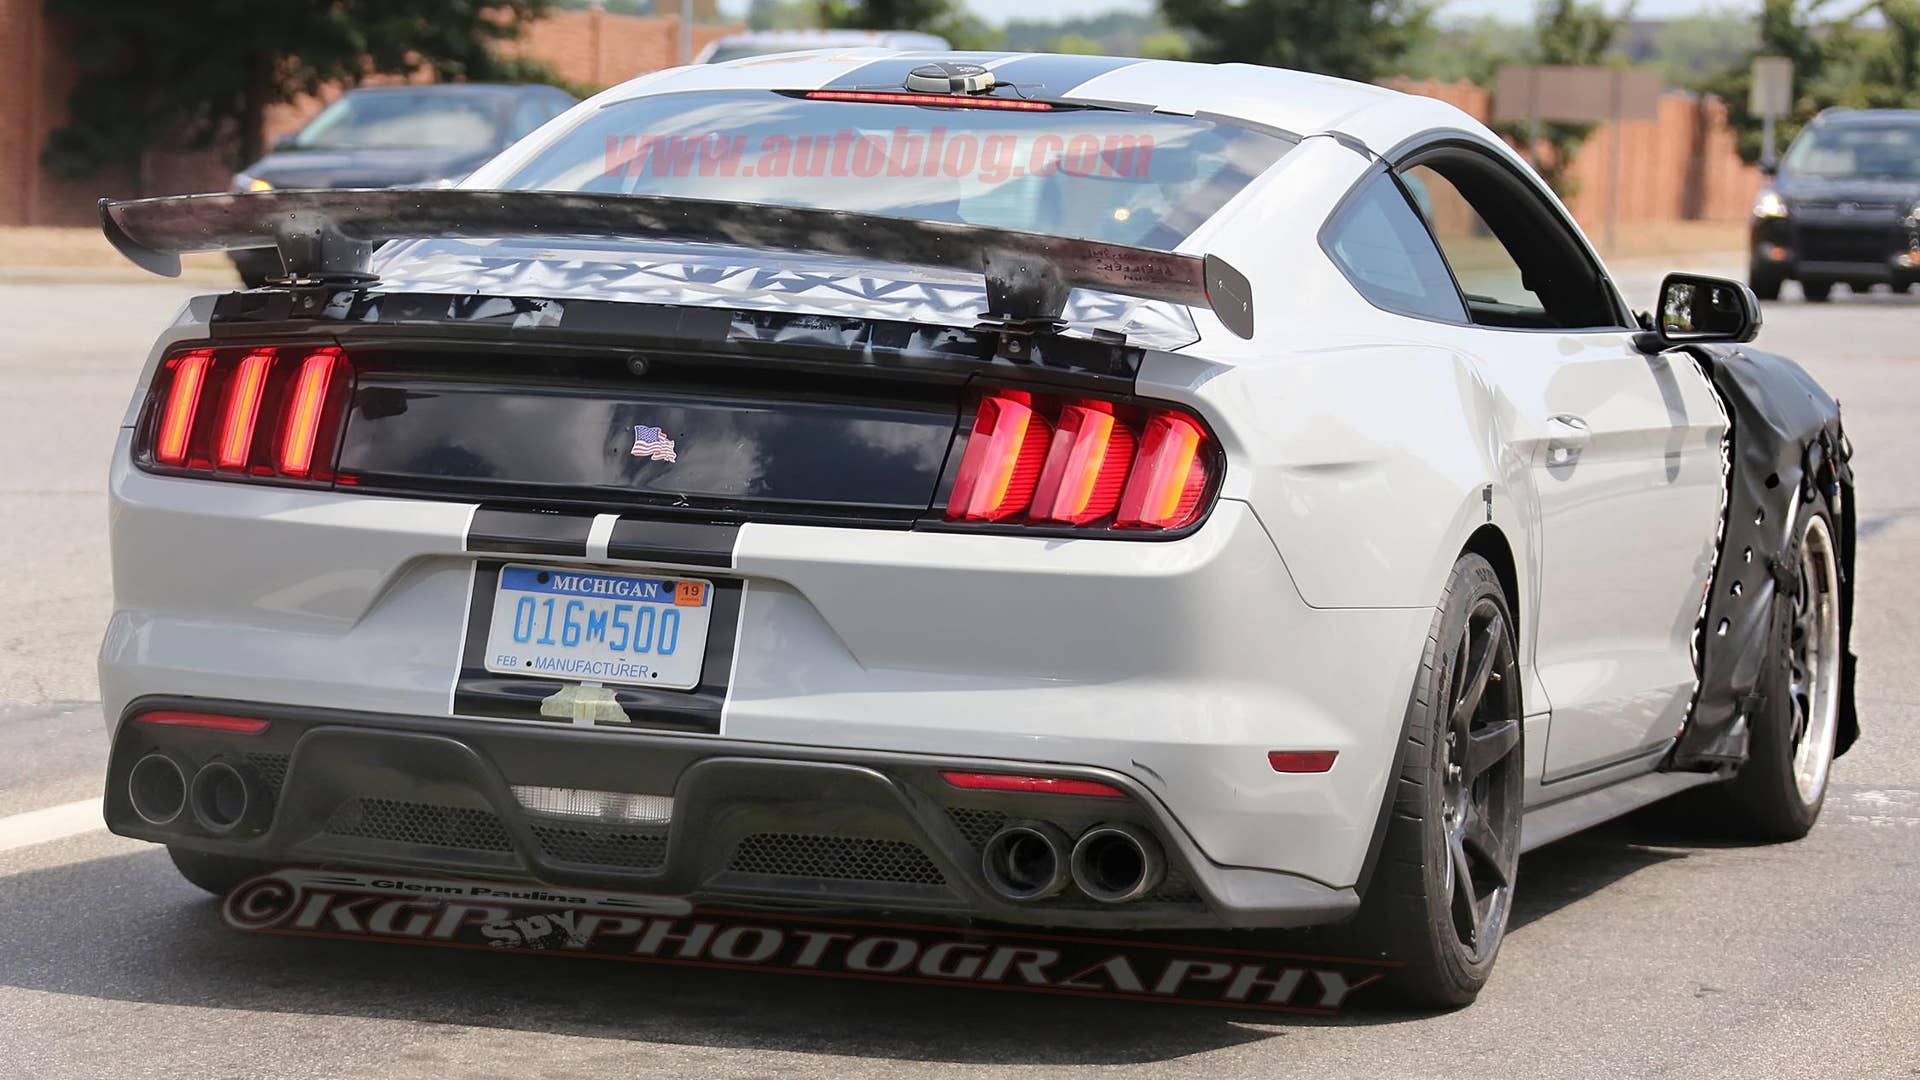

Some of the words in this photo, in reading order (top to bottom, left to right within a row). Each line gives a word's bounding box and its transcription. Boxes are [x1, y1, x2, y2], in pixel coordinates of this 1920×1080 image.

[552, 575, 658, 598] MICHIGAN
[683, 586, 699, 596] 19
[513, 596, 681, 656] 016M500
[496, 655, 518, 667] FEB
[535, 656, 649, 679] MANUFACTURER
